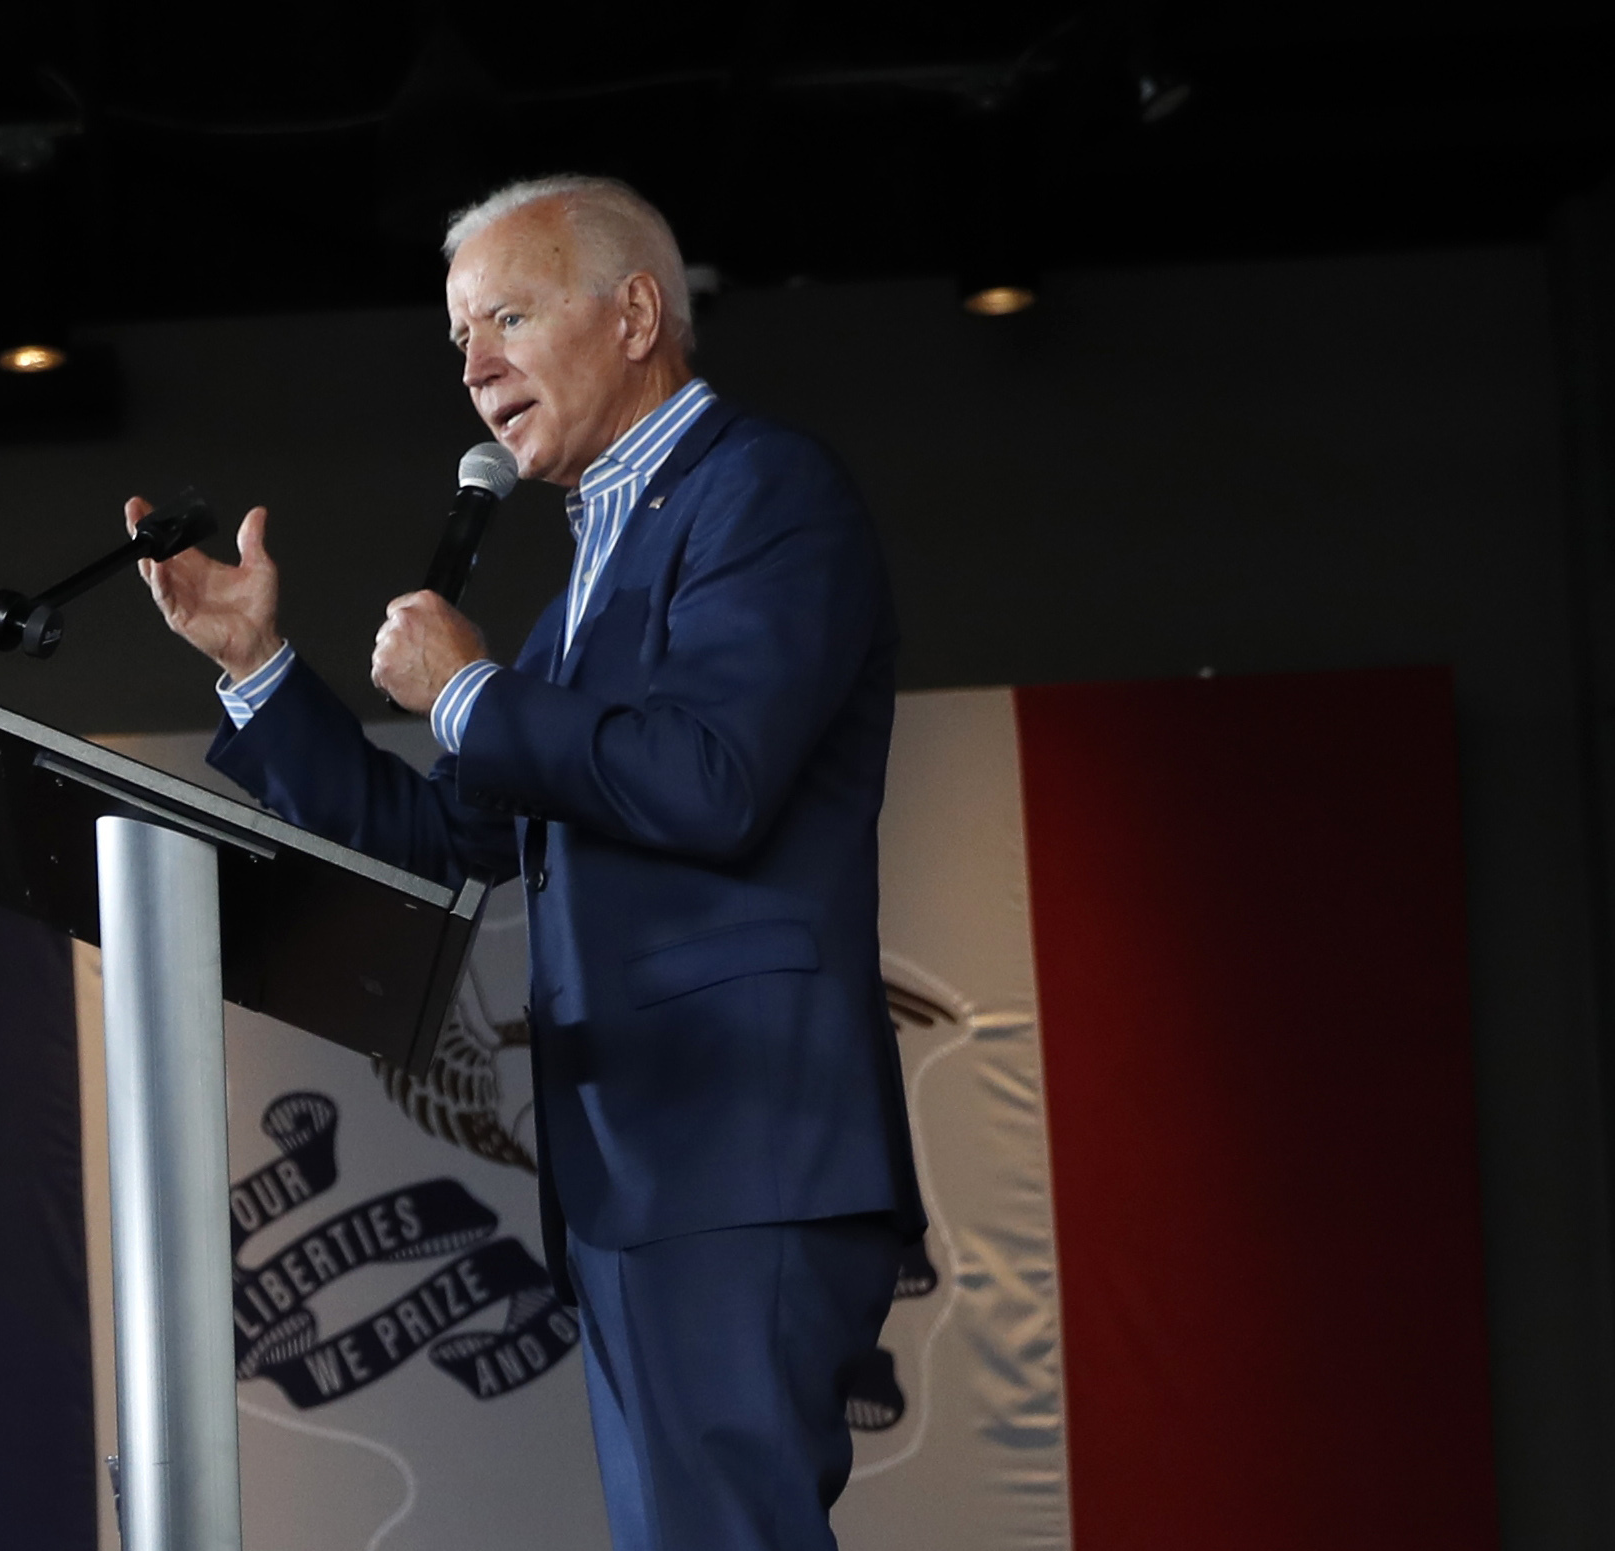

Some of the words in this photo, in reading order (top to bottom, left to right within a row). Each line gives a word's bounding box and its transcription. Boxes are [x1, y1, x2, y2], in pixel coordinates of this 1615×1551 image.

[230, 1160, 312, 1232] OUR
[233, 1196, 422, 1340] LIBERTIES
[303, 1336, 372, 1397] WE
[375, 1258, 490, 1361] PRIZE
[474, 1334, 548, 1396] AND
